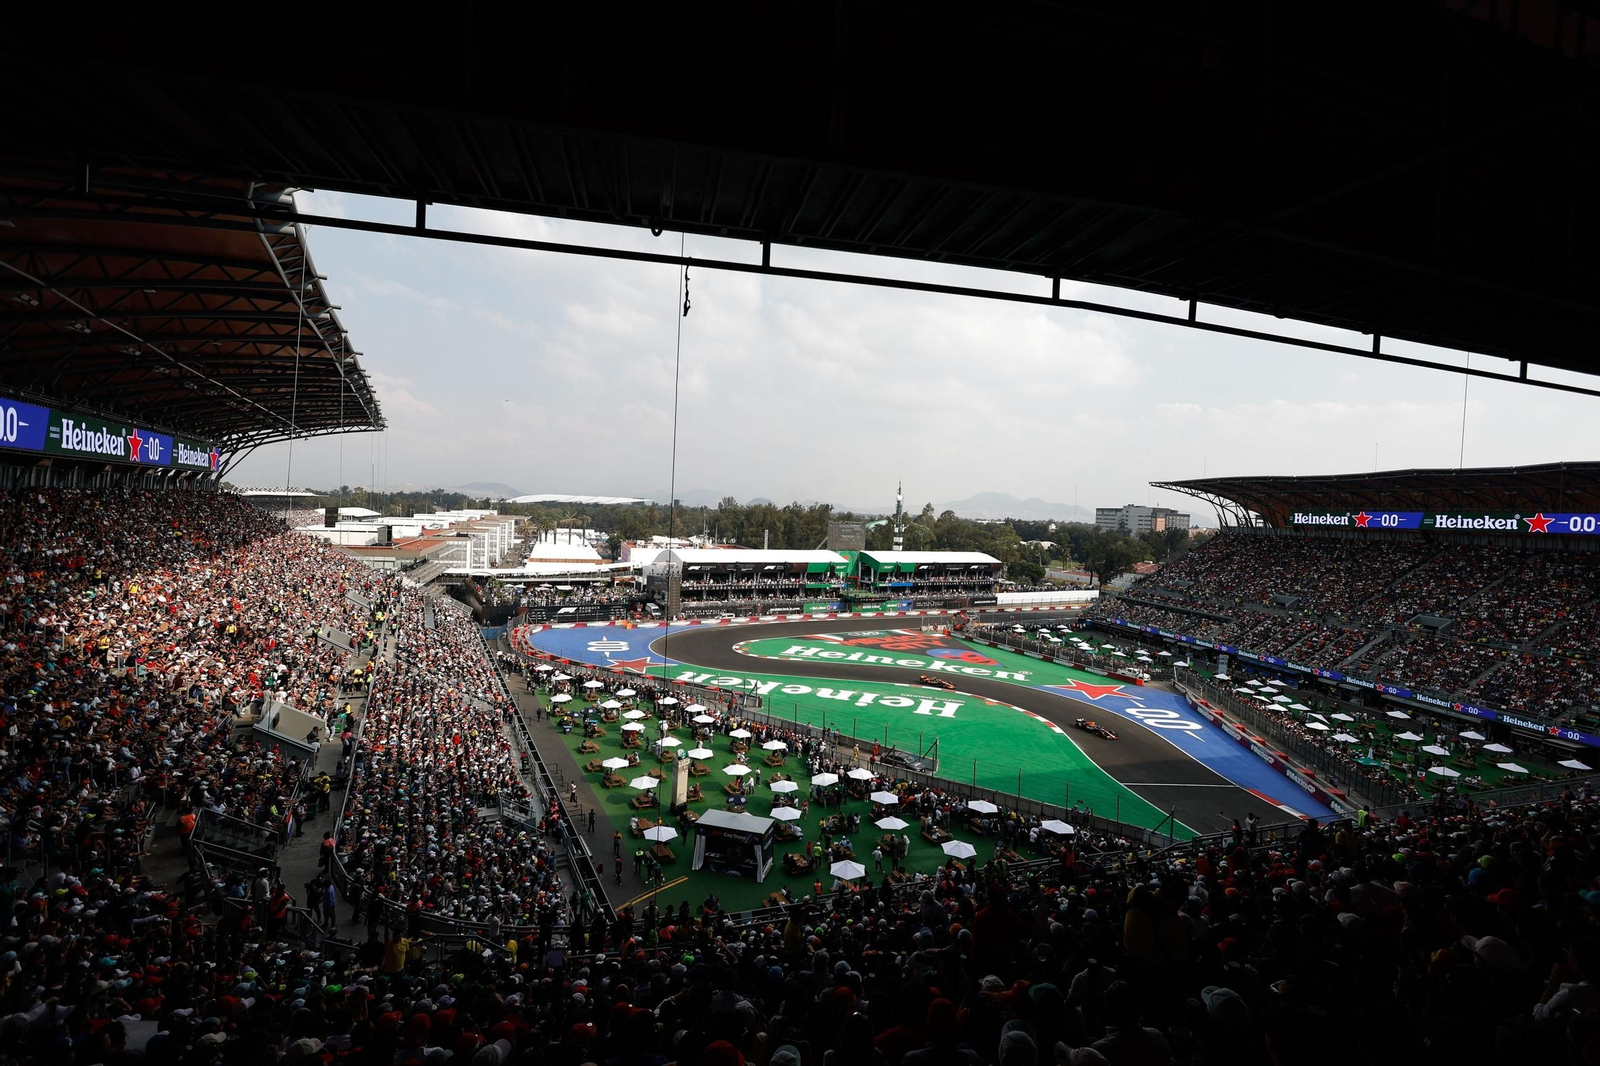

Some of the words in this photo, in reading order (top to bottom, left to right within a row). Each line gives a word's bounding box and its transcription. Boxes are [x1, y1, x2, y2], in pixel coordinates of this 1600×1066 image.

[61, 418, 125, 456] Heineken
[178, 443, 209, 467] Heineken
[1294, 512, 1349, 525] Heineken
[1381, 514, 1398, 527] 0.0
[1435, 514, 1518, 530] Heineken
[1569, 516, 1596, 532] 0.0
[781, 645, 1030, 682] Heineken
[676, 671, 965, 718] Heineken
[1346, 676, 1374, 689] Heineken
[1416, 693, 1450, 708] Heineken
[1503, 715, 1545, 732] Heineken
